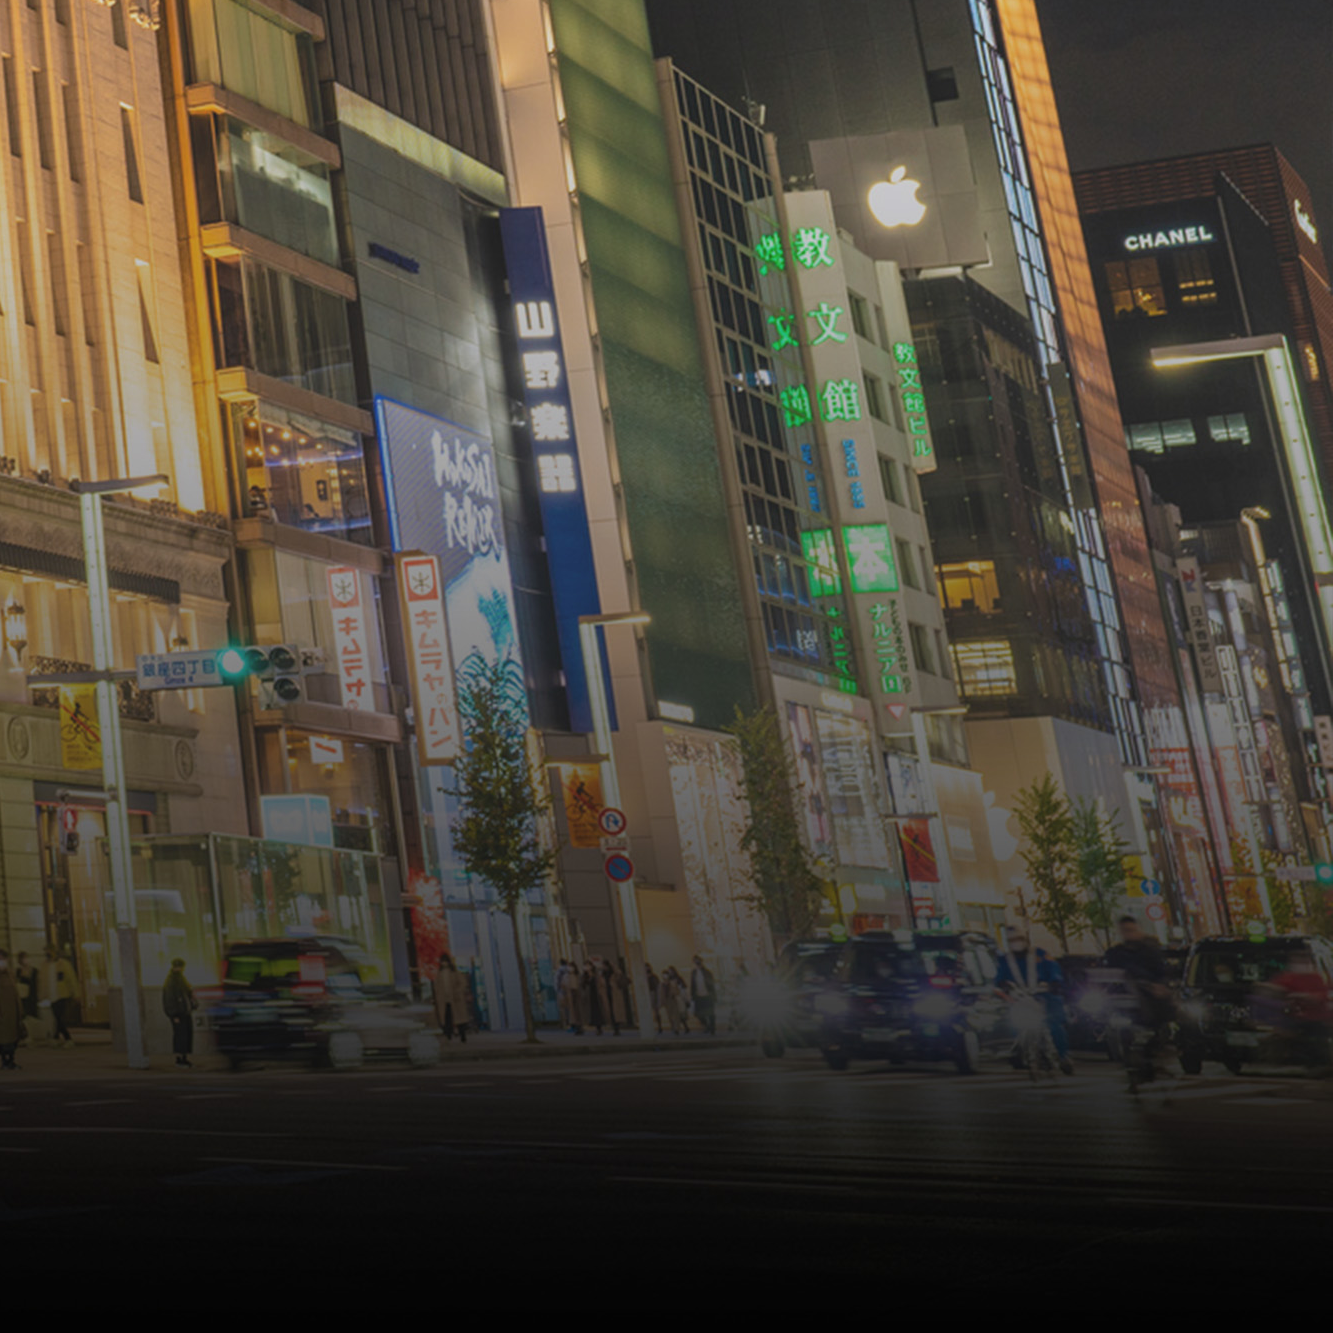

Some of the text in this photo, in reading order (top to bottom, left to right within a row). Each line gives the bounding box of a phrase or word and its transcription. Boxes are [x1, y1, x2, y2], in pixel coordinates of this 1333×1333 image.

[1123, 224, 1215, 253] CHANEL
[793, 226, 863, 424] 教文館
[514, 300, 578, 494] 山野楽器
[892, 341, 932, 458] 教文館ビル
[142, 658, 216, 678] 銀座四丁目
[414, 608, 455, 750] キムラヤのパン
